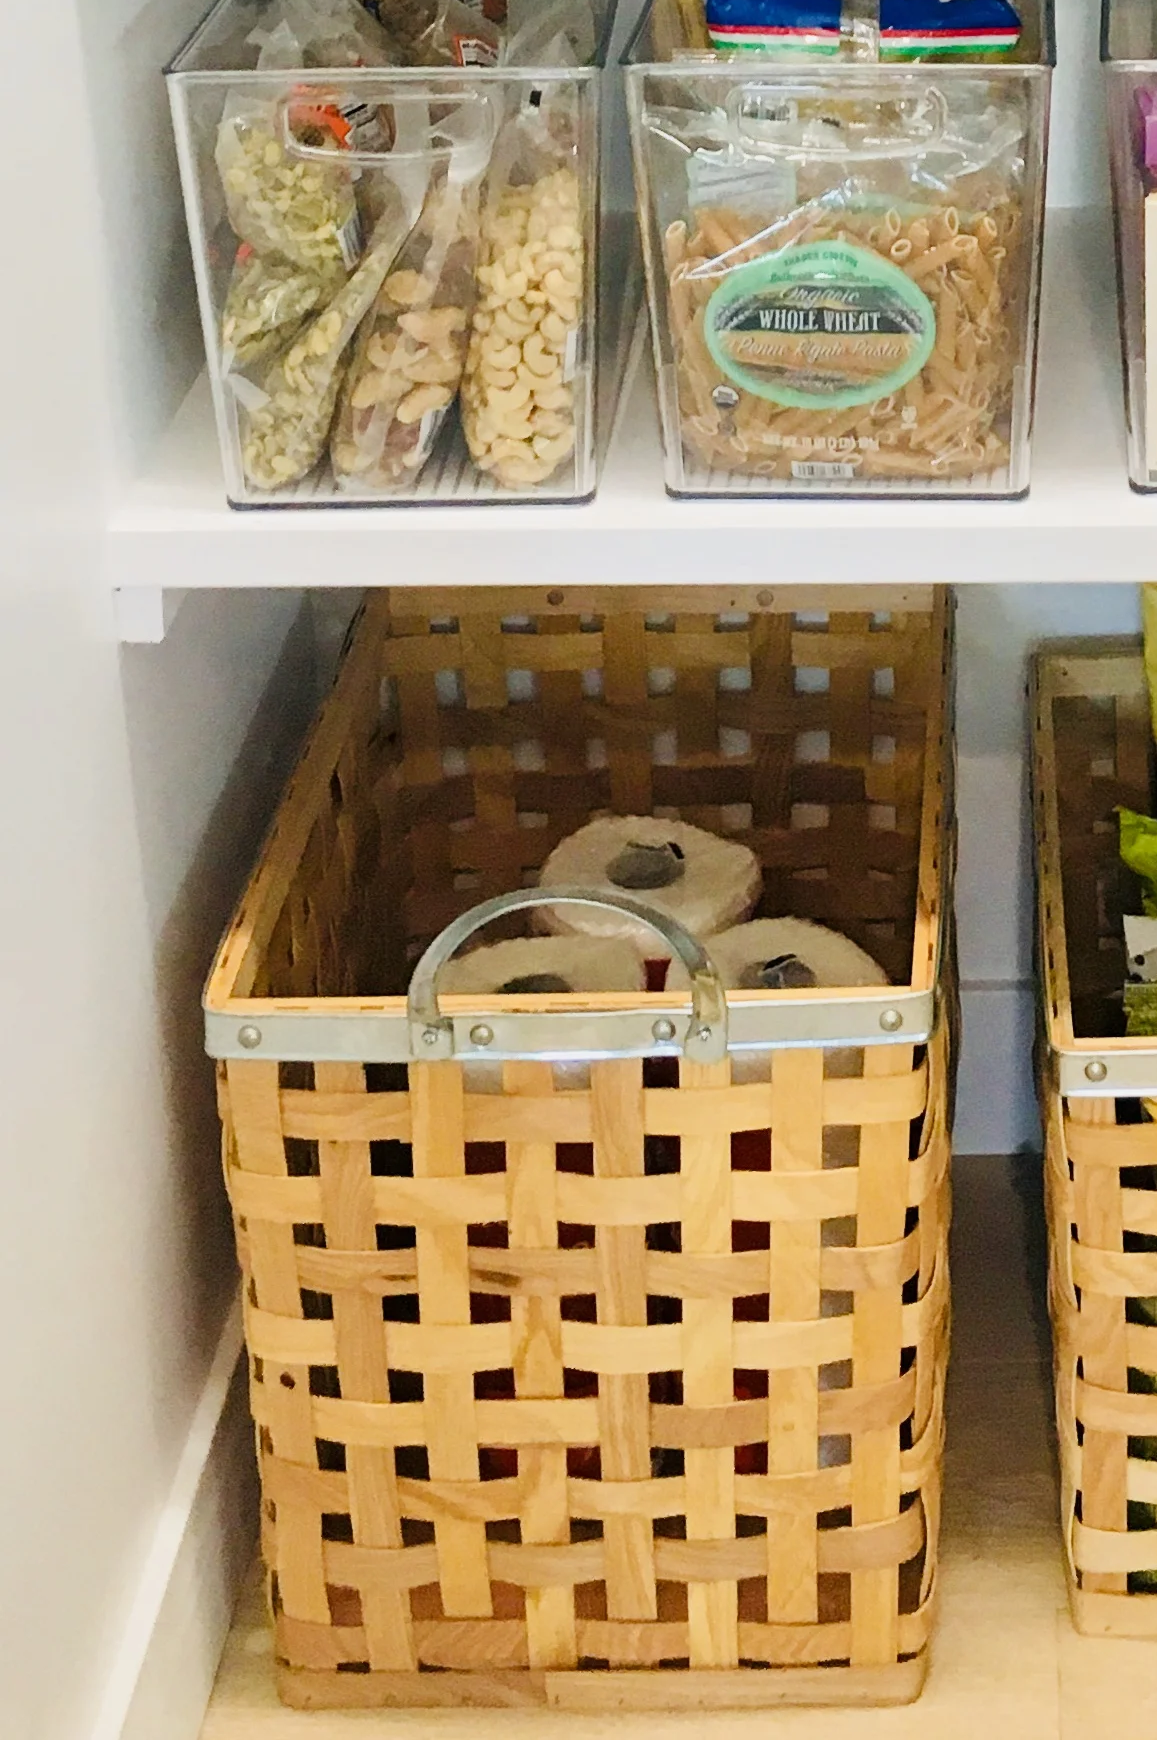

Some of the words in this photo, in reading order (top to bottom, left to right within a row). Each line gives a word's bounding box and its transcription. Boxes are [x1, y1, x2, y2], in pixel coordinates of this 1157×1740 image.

[780, 287, 860, 310] Organic
[759, 309, 819, 332] WHOLE
[823, 309, 881, 332] WHEAT
[850, 338, 902, 358] Pasta
